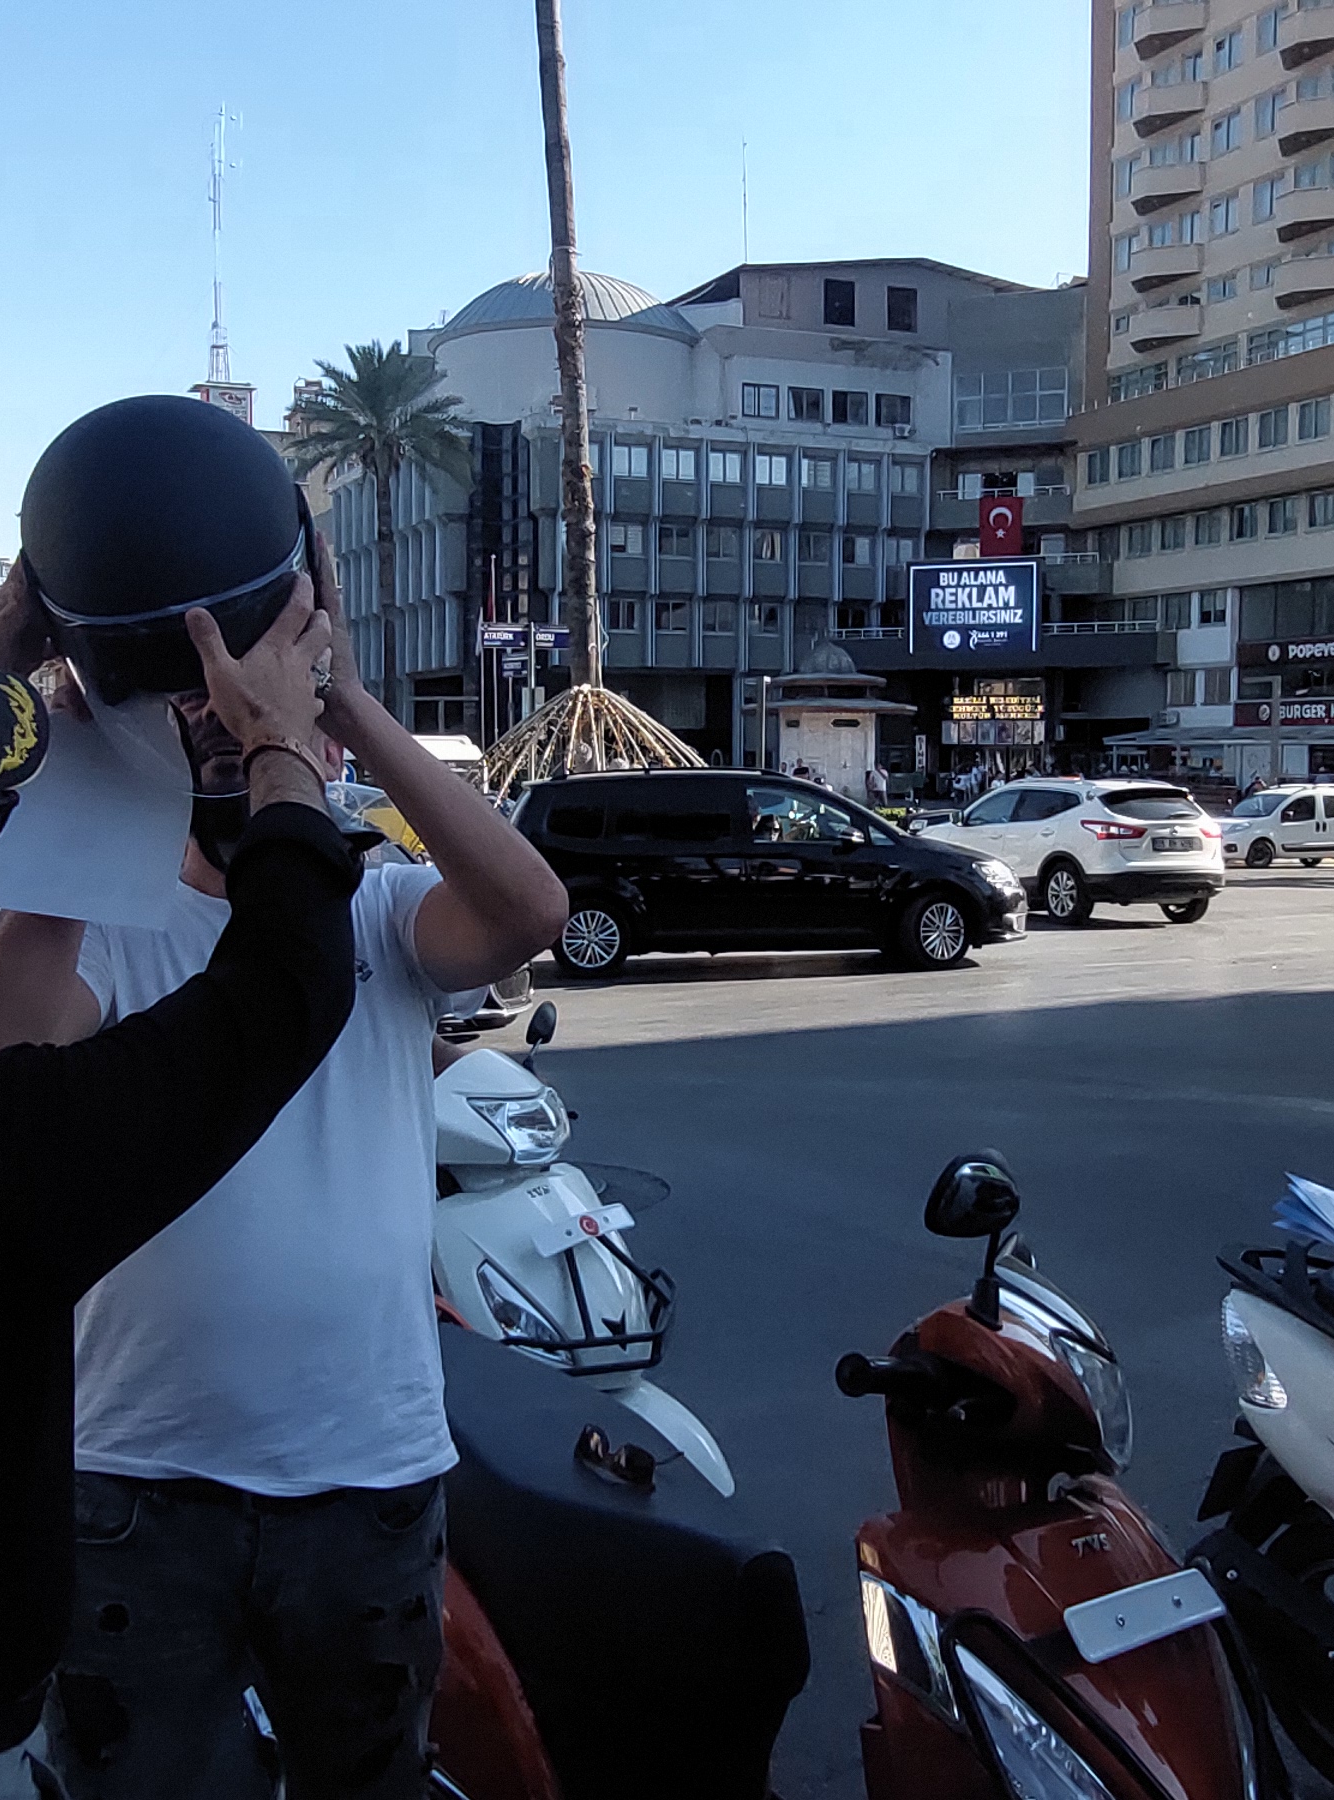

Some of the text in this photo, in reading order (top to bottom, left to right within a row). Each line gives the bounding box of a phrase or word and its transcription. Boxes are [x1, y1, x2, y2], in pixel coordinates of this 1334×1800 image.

[939, 570, 1007, 587] BU ALANA
[930, 586, 1016, 609] REKLAM
[1279, 704, 1327, 719] BURGER
[527, 1185, 550, 1199] TVS
[1071, 1533, 1112, 1559] TVS
